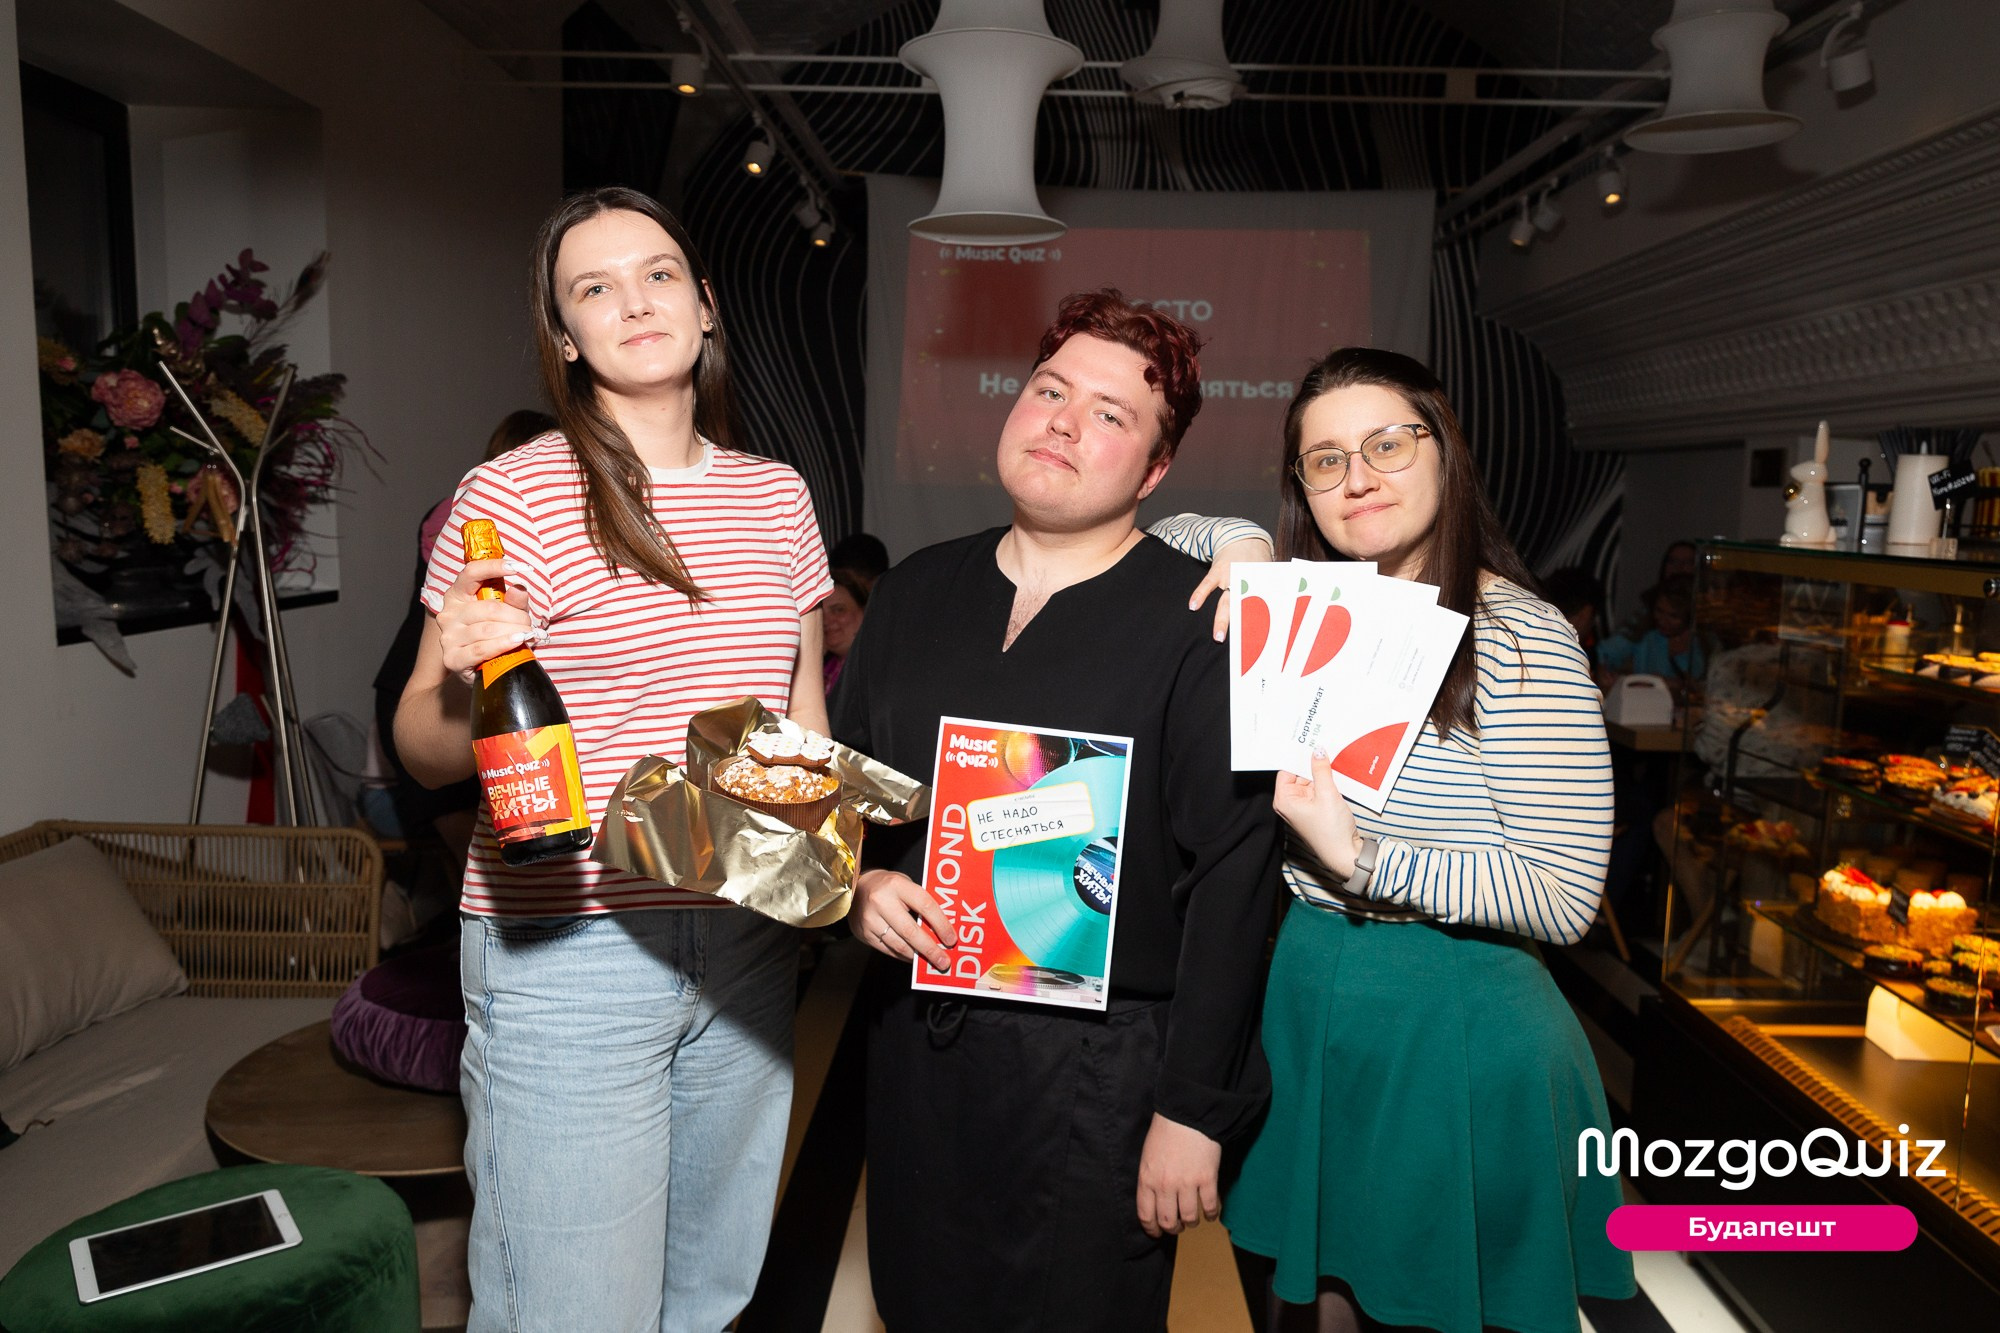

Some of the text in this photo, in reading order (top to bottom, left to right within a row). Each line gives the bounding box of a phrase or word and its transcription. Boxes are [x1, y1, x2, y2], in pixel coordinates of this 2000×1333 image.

[979, 372, 1020, 395] Не
[1298, 686, 1325, 744] Сертификат
[487, 775, 551, 801] ВЕЧНЫЕ
[490, 789, 559, 820] ХИТЫ
[977, 806, 1038, 825] НЕ НАДО
[980, 819, 1064, 843] СТЕСНЯТЬСЯ
[1074, 868, 1112, 905] ХИТЫ
[955, 900, 987, 980] DISK
